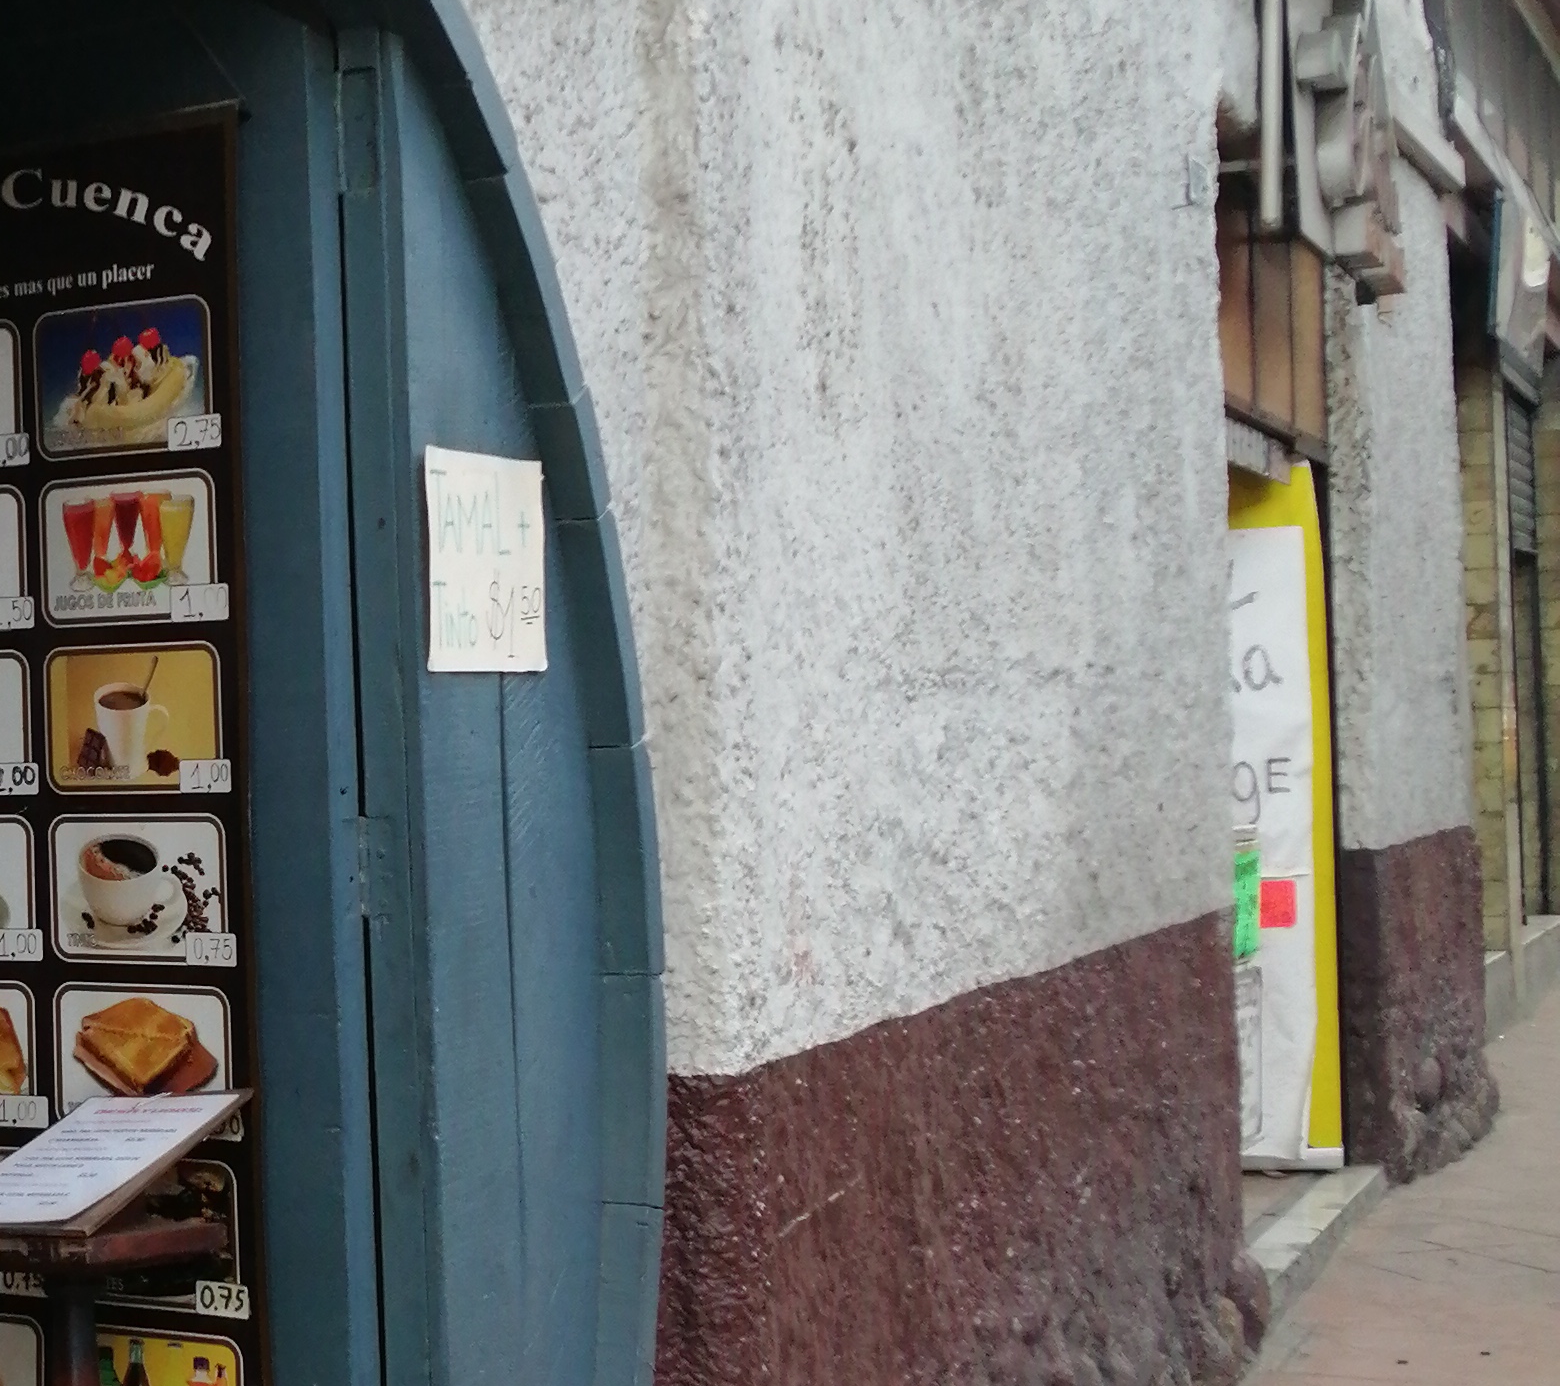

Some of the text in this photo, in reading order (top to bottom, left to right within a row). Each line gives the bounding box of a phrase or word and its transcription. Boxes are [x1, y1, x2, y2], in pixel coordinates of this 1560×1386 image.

[0, 168, 212, 262] Cuenca
[14, 279, 43, 297] mas
[46, 273, 74, 296] que
[77, 269, 97, 288] un
[101, 262, 155, 289] placer
[430, 469, 511, 556] TAMAL
[53, 592, 158, 612] JUGOS DE FRUTA
